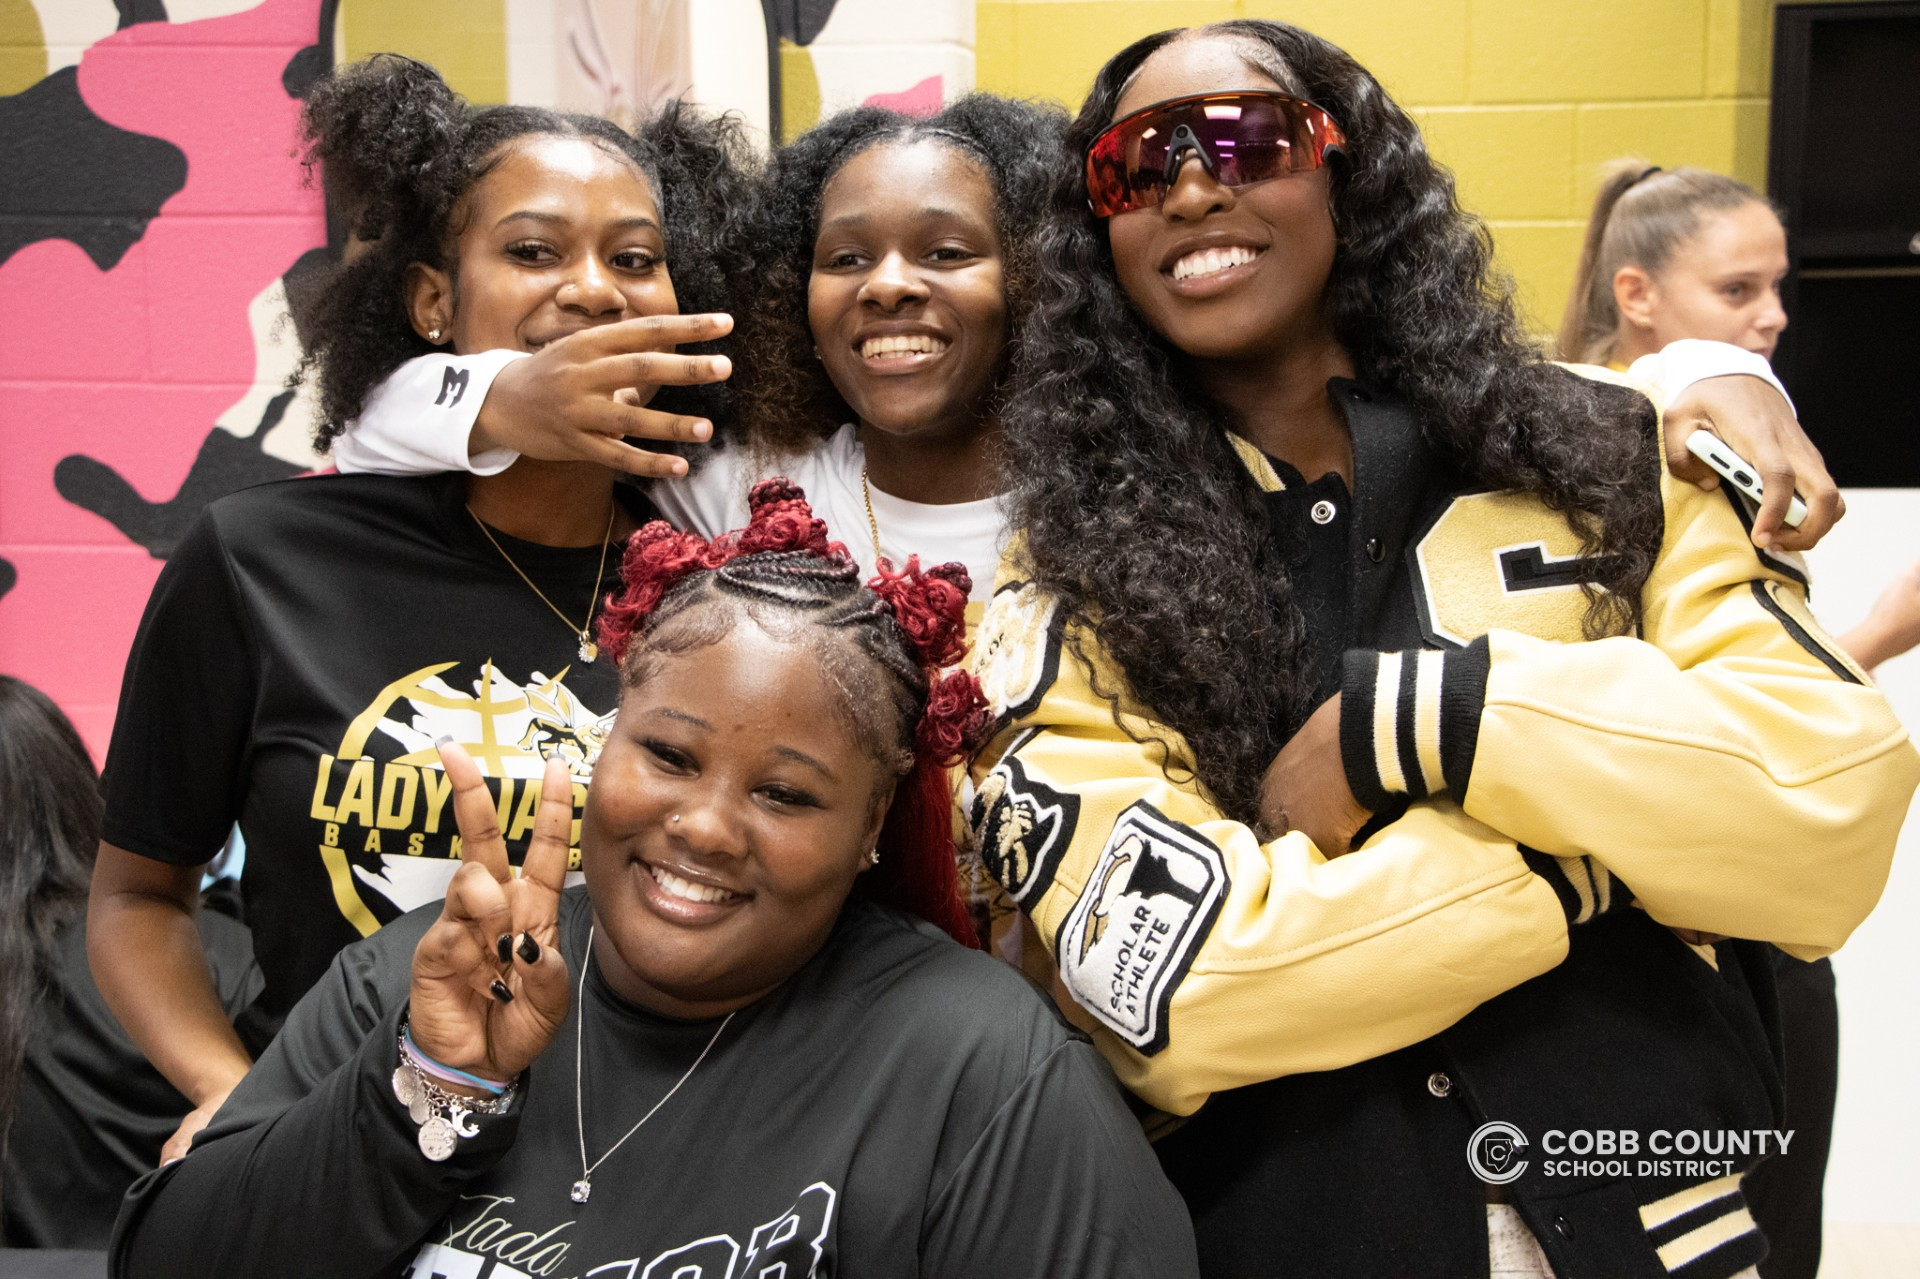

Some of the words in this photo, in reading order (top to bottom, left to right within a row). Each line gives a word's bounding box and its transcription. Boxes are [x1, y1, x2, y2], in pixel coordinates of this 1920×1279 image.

[310, 754, 453, 834] LADY
[1110, 904, 1152, 1012] SCHOLAR
[1126, 918, 1171, 1017] ATHLETE
